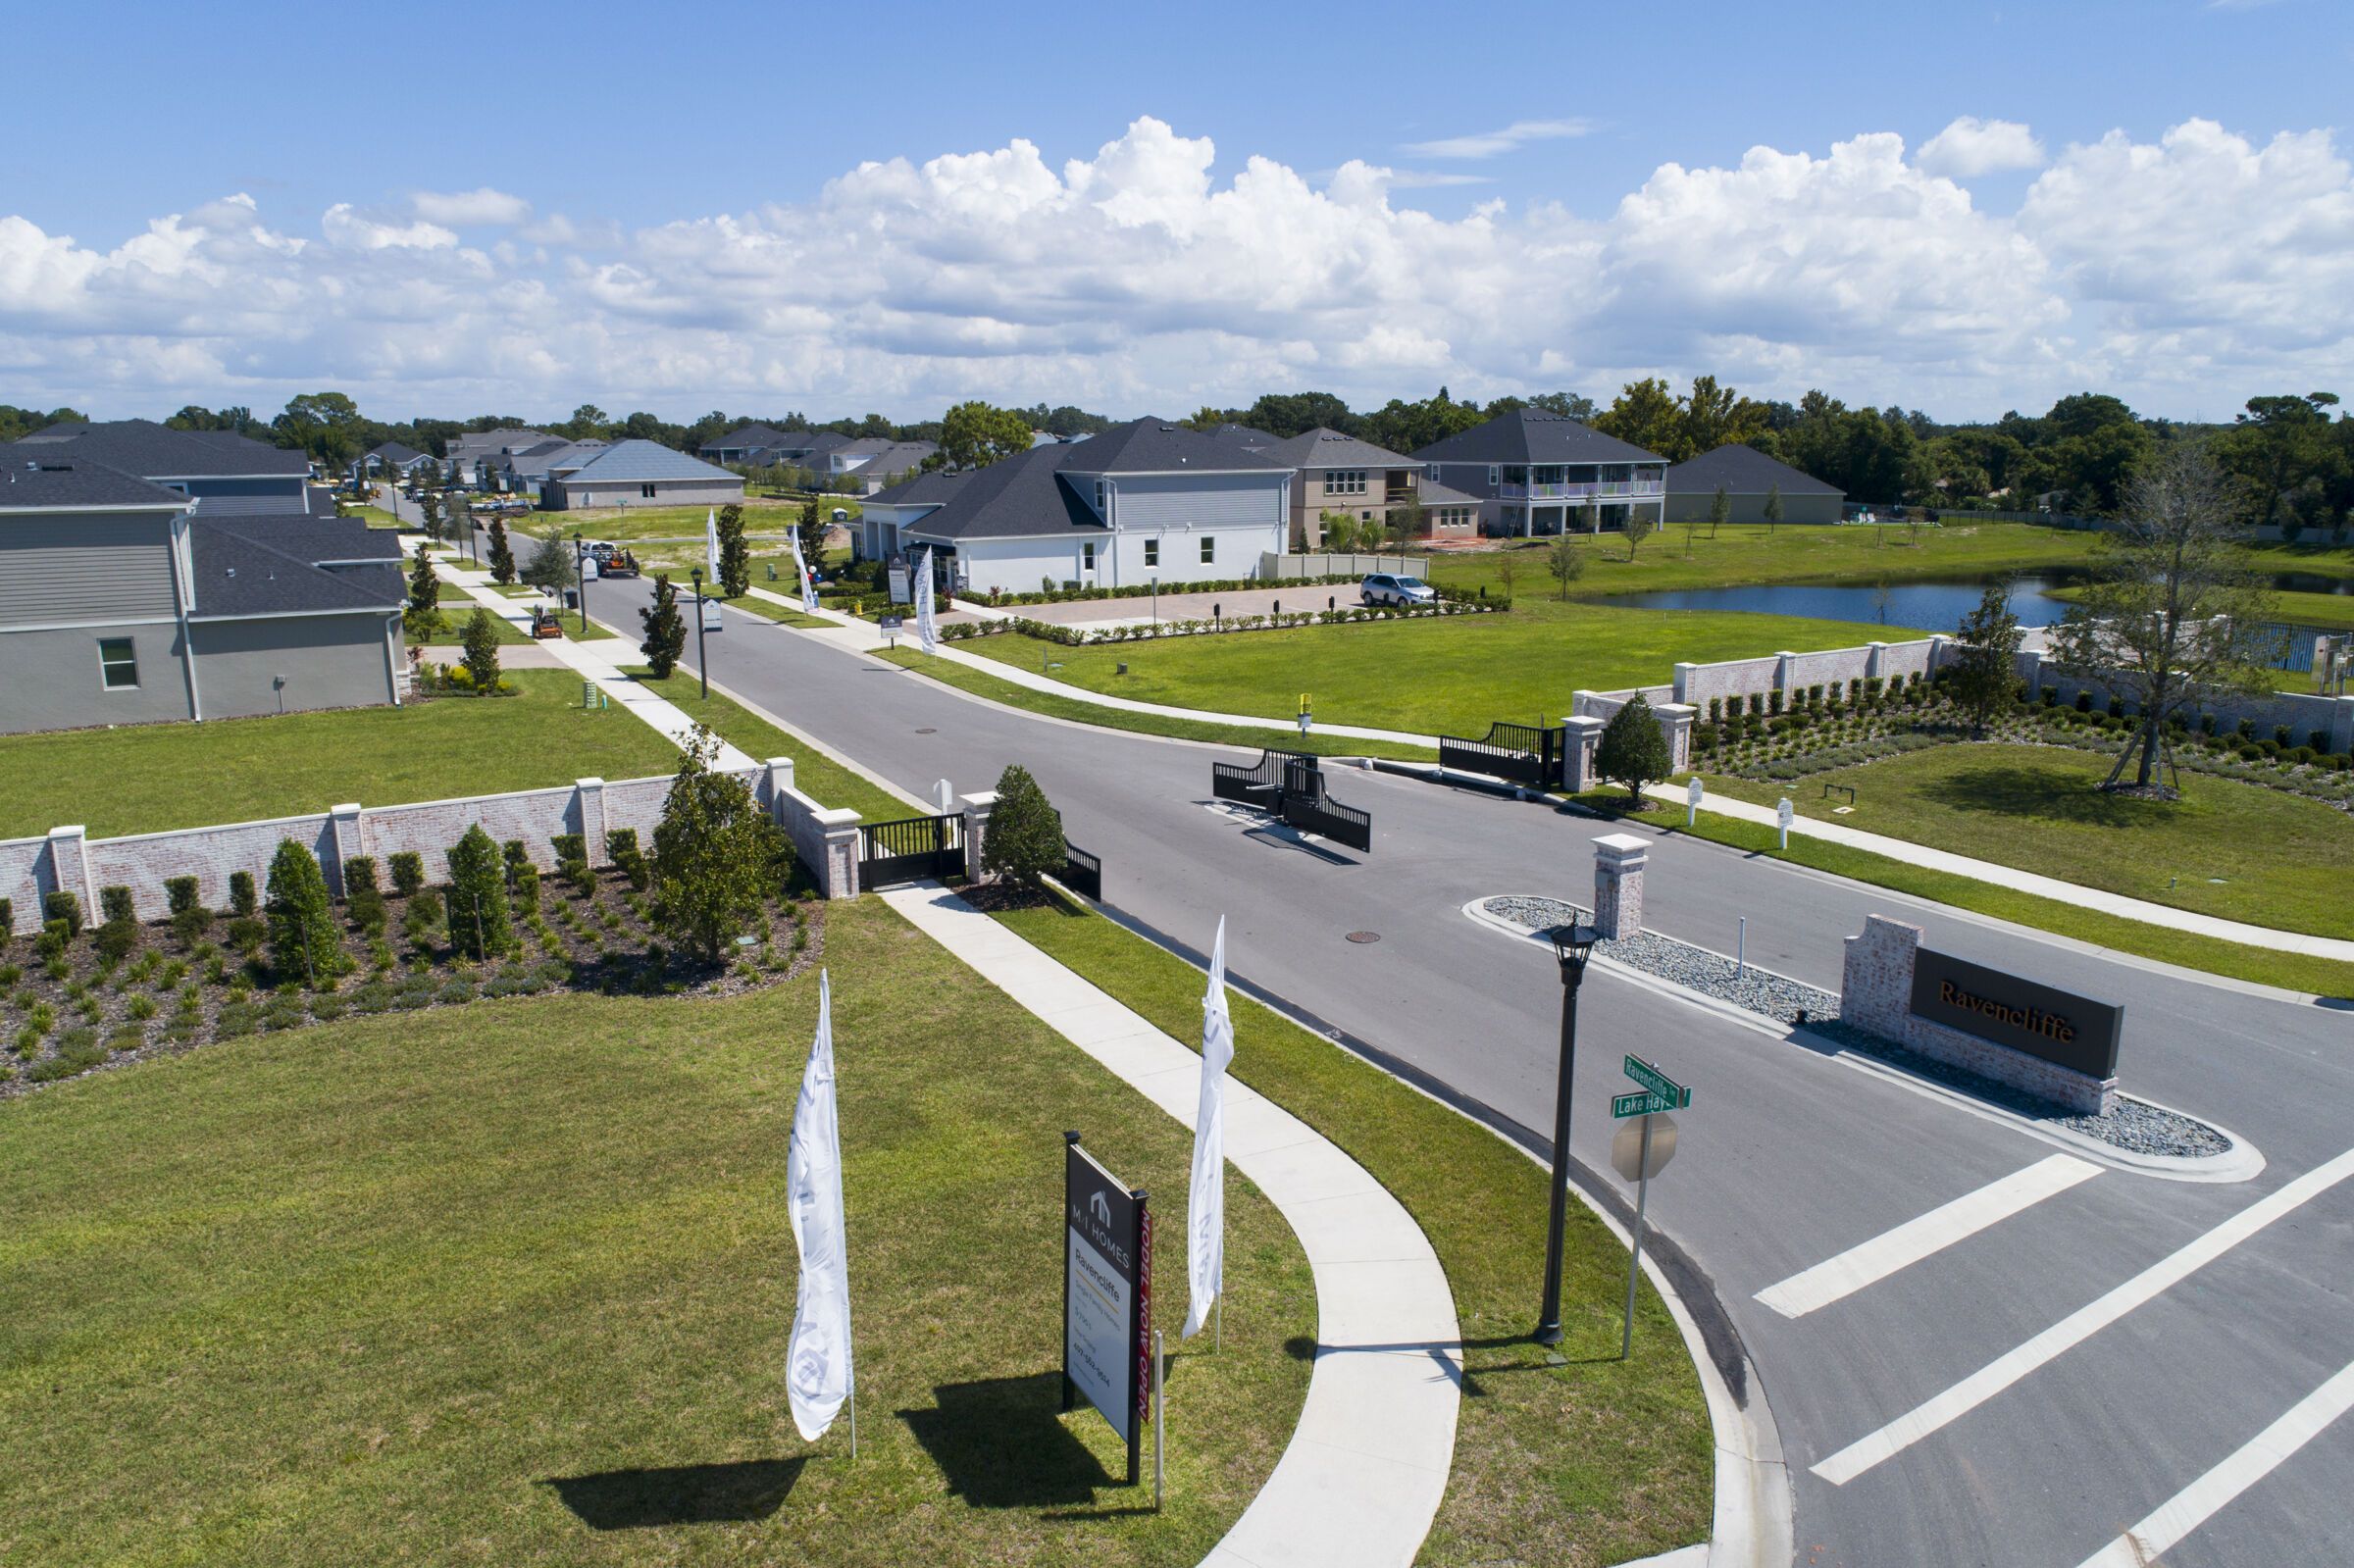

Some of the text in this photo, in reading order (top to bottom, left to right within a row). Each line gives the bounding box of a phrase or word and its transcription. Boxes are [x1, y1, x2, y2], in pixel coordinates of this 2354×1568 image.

[1939, 980, 2073, 1044] Ravencliffe
[1626, 1059, 1667, 1098] Ravencliffe
[1618, 1093, 1670, 1114] Lake Hay
[1092, 1226, 1130, 1270] HOMES
[1075, 1248, 1120, 1303] Ravencliffe
[1138, 1209, 1151, 1419] MODEL NOW OPEN
